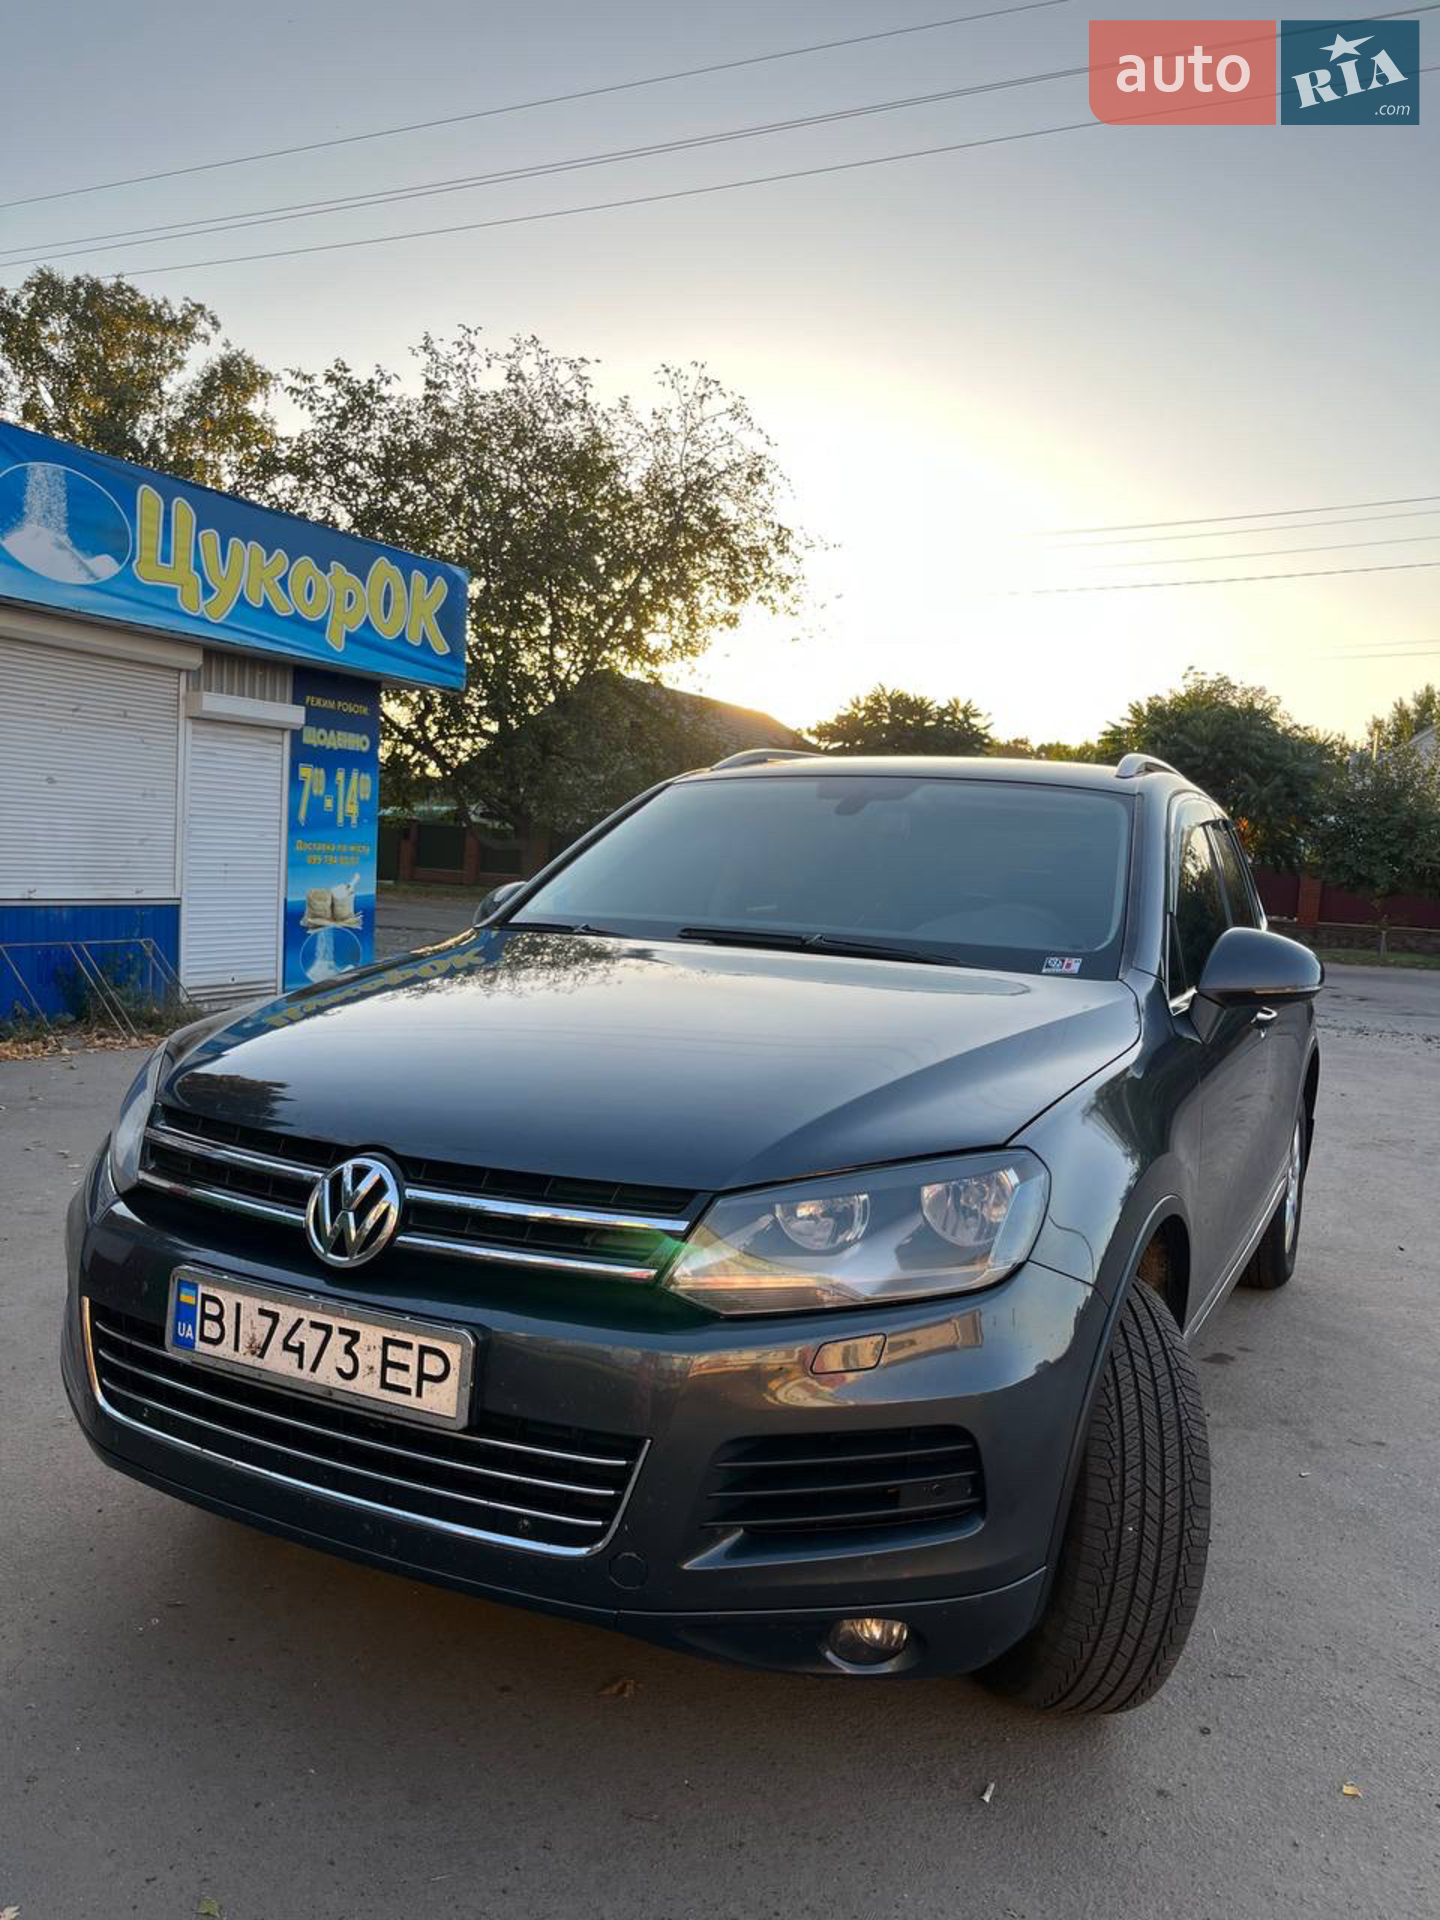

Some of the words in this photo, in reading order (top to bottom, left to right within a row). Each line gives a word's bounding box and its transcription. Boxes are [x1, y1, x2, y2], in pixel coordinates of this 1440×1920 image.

[305, 695, 336, 710] РЕЖИМ
[302, 725, 371, 752] ЩОДЕННО
[177, 1322, 194, 1340] UA
[199, 1292, 242, 1353] BI
[257, 1307, 361, 1381] 7473
[379, 1335, 451, 1399] EP
